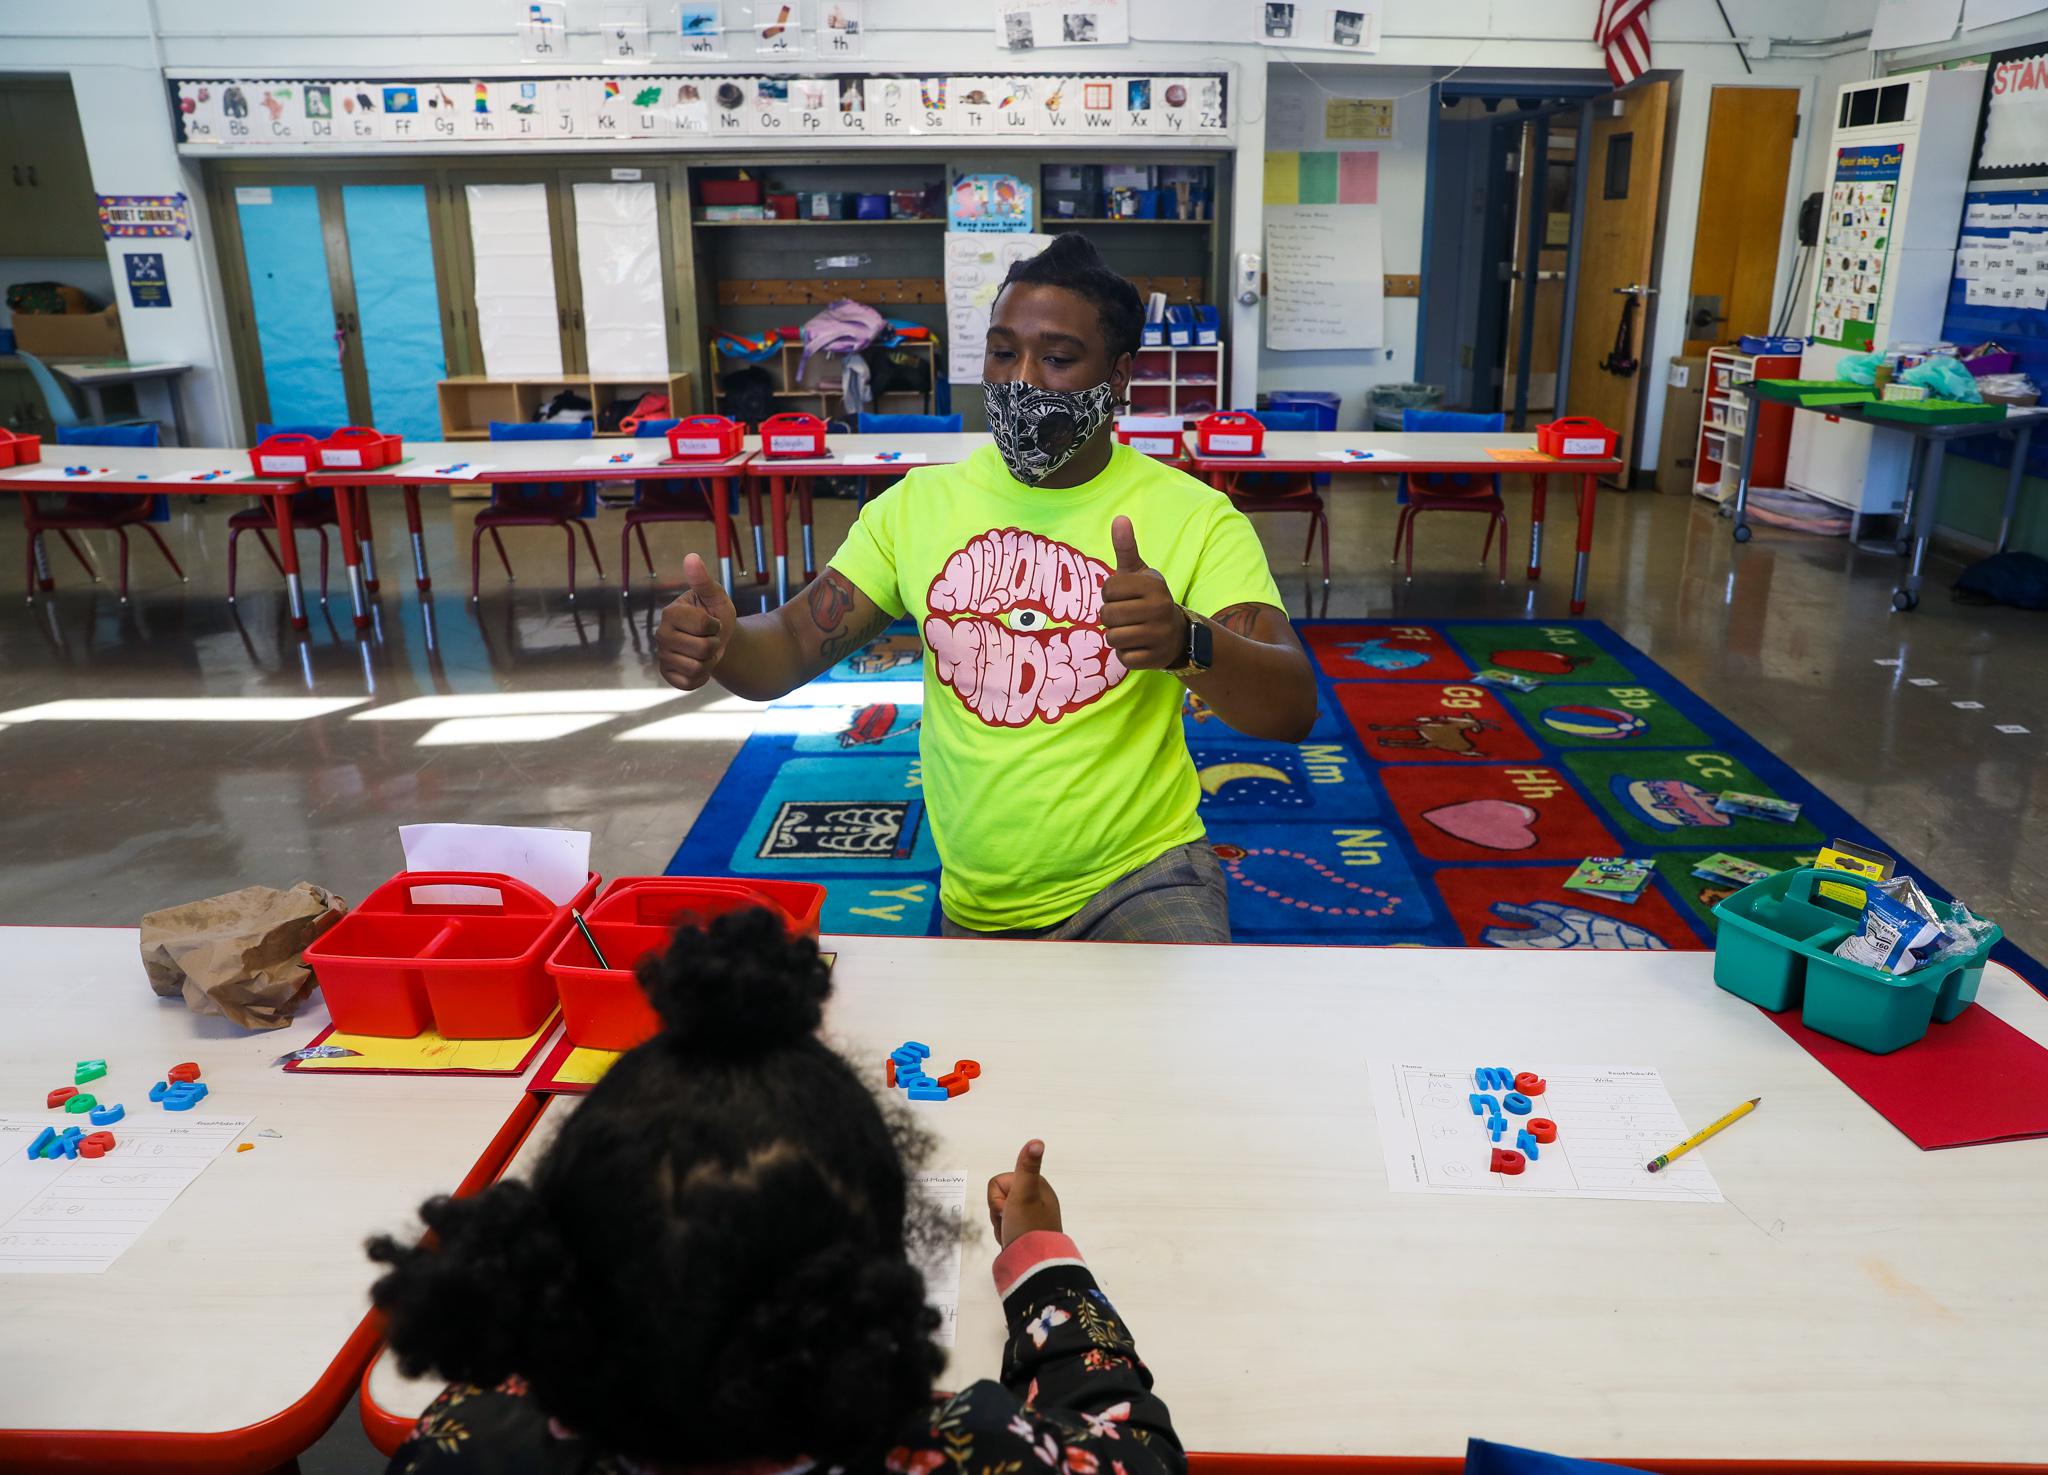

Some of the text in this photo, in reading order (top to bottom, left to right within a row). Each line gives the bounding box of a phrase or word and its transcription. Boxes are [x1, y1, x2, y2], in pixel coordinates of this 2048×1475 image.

[536, 39, 552, 53] ch
[692, 39, 713, 52] wh
[833, 38, 848, 51] th
[191, 120, 210, 135] Aa
[230, 121, 249, 136] Bb
[272, 122, 291, 136] Cc
[312, 121, 331, 136] Dd
[354, 120, 372, 136] Ee
[396, 120, 411, 135] Ff
[435, 117, 454, 134] Gg
[475, 116, 494, 131] Hh
[521, 119, 531, 133] Ii
[560, 116, 574, 133] Jj
[600, 115, 615, 129] Kk
[642, 114, 653, 129] Ll
[721, 113, 739, 128] Nn
[762, 113, 780, 128] Oo
[803, 113, 820, 131] Pp
[843, 112, 865, 130] Qq
[885, 113, 901, 128] Rr
[926, 112, 943, 127] Ss
[968, 112, 982, 127] Tt
[1008, 112, 1025, 127] Uu
[1049, 112, 1067, 127] Vv
[1085, 113, 1111, 127] Ww
[1131, 112, 1147, 127] Xx
[1165, 113, 1182, 130] Yy
[1200, 113, 1217, 128] Zz
[929, 529, 1114, 625] MILLIONAIR
[1298, 745, 1348, 783] Mm
[1504, 769, 1563, 799] Hh
[1332, 829, 1388, 866] Nn
[849, 884, 927, 922] Yy
[1875, 942, 1889, 950] 160
[1475, 1067, 1547, 1096] me
